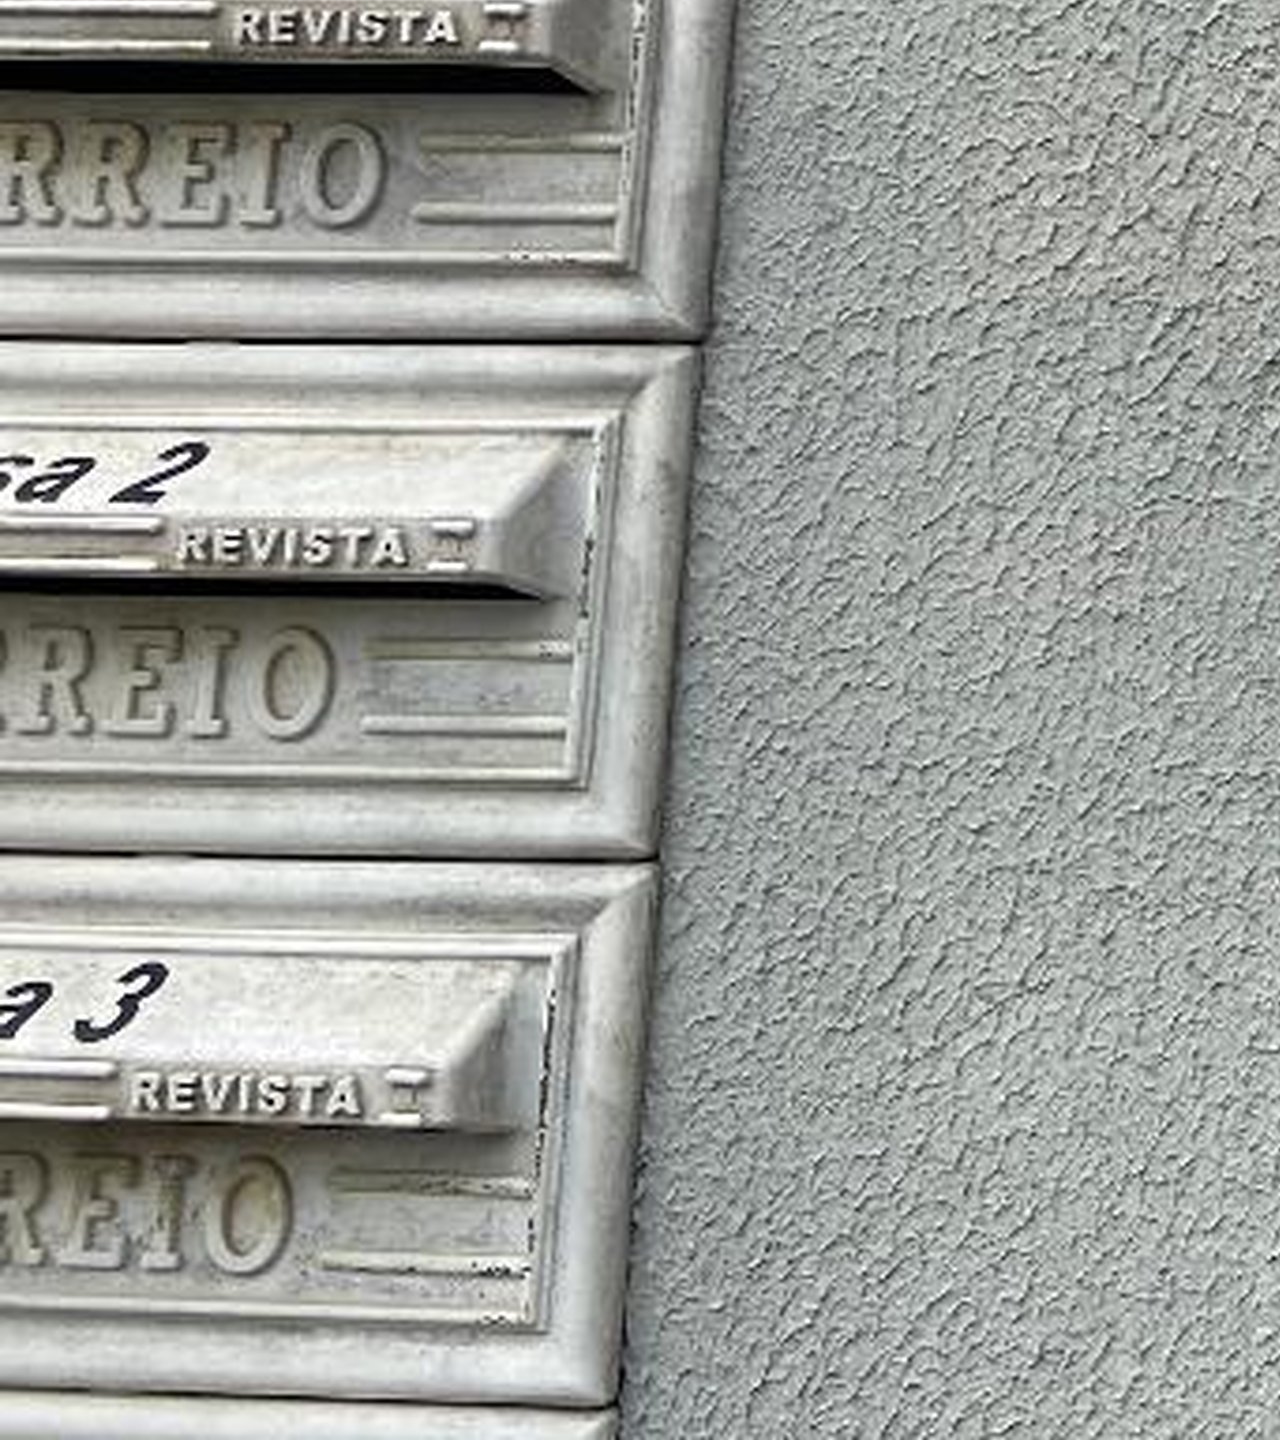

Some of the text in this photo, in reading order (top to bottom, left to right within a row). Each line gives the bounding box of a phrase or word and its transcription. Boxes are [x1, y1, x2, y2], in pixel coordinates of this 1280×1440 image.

[234, 9, 458, 44] REVISTA
[108, 442, 210, 504] 2
[176, 527, 408, 566] REVISTA
[0, 622, 338, 742] REIO
[73, 960, 169, 1043] 3
[131, 1071, 364, 1119] REVISTA
